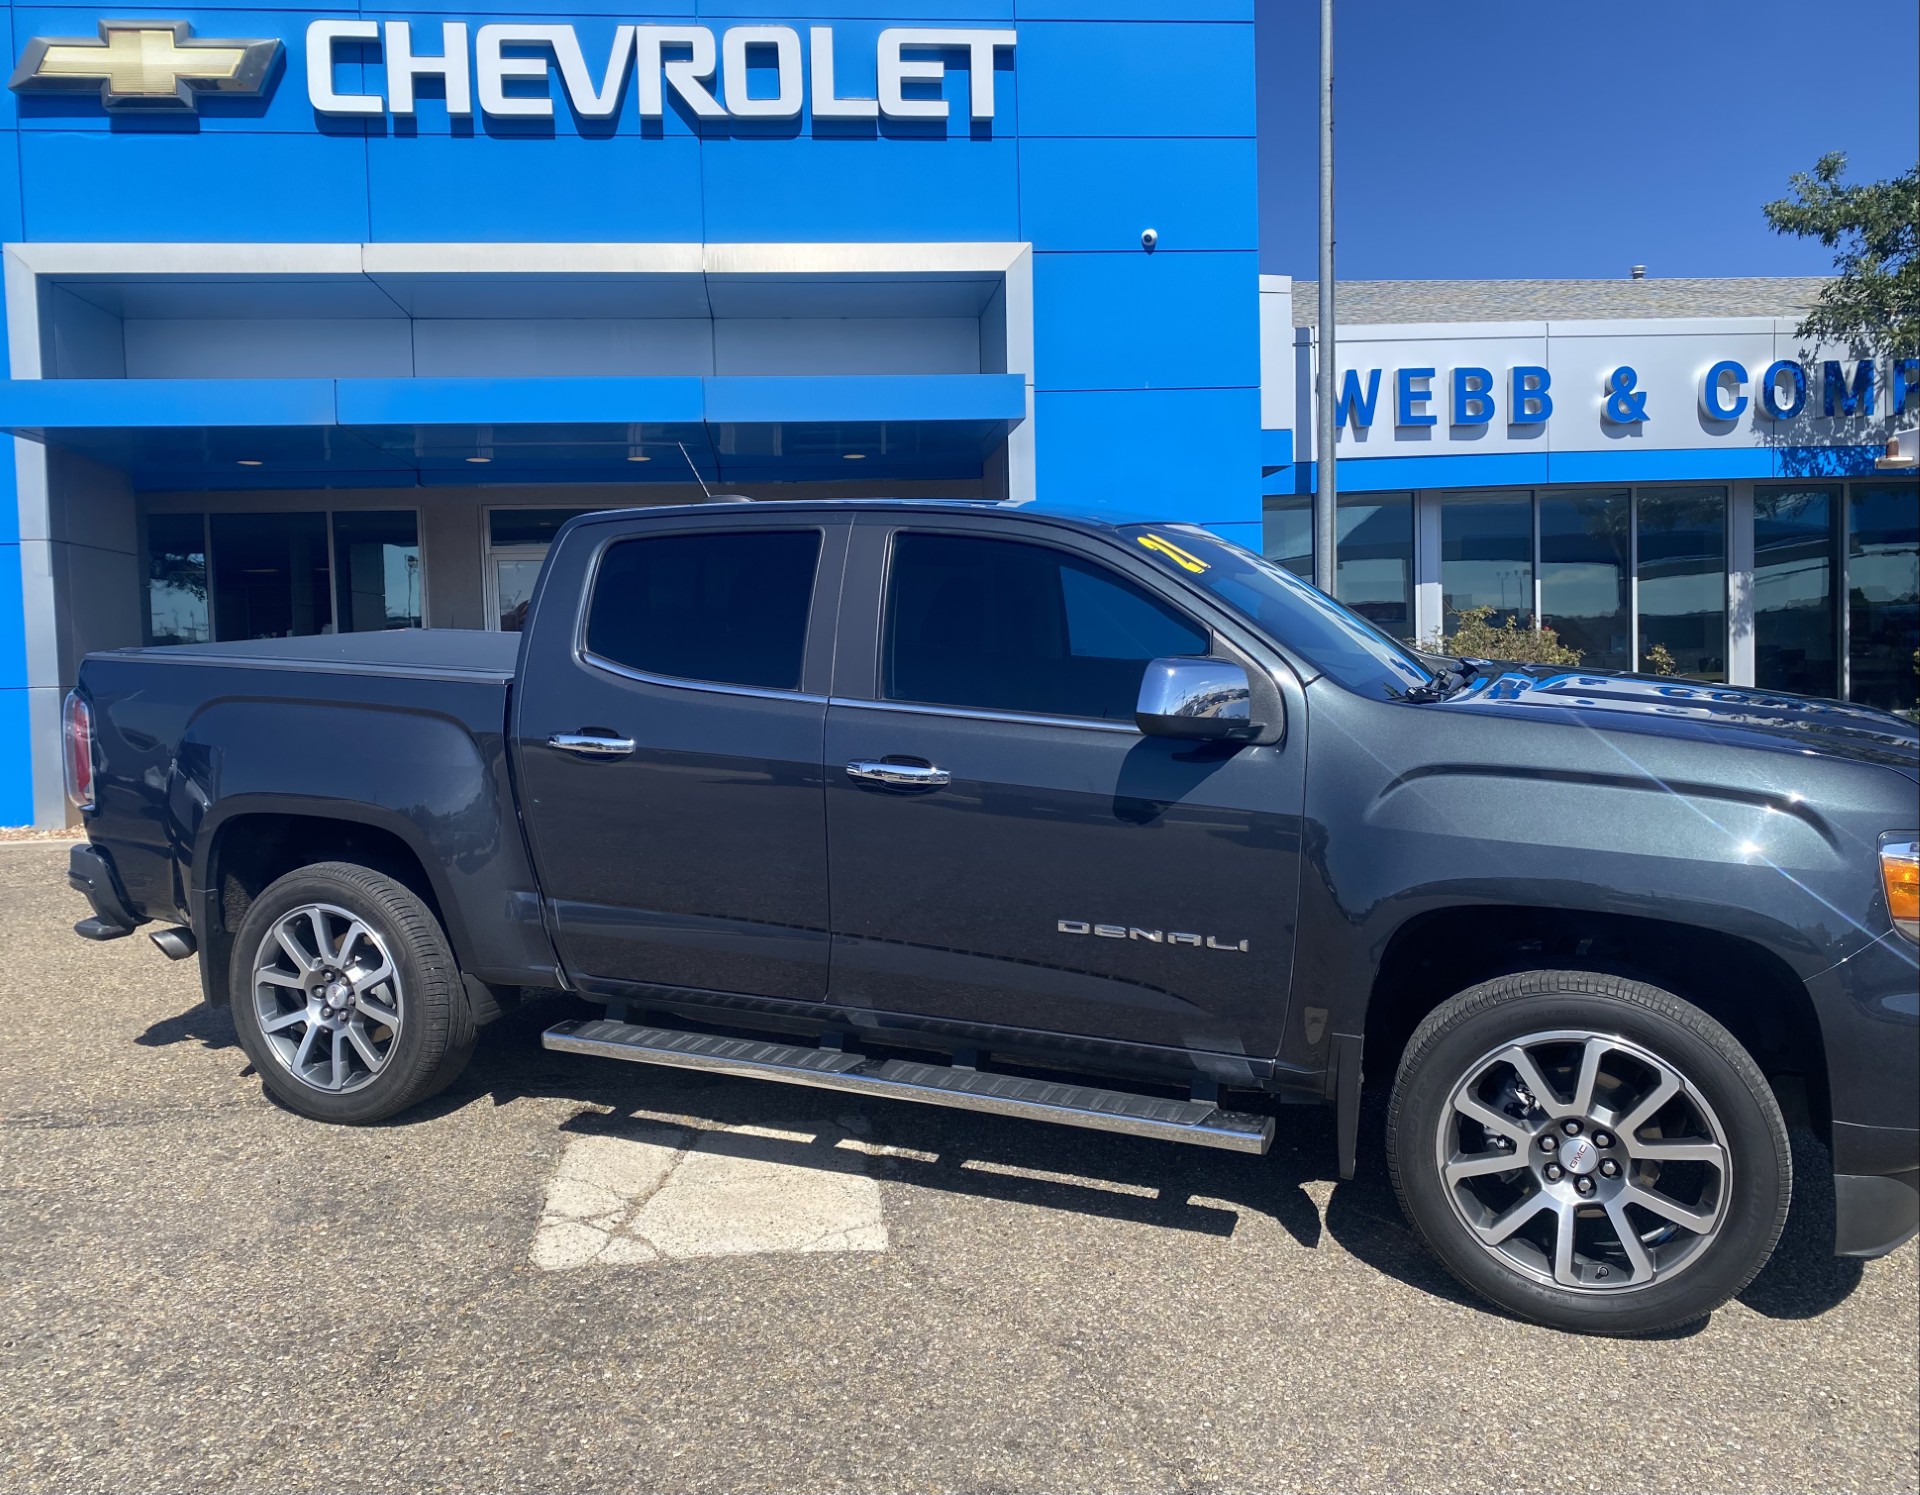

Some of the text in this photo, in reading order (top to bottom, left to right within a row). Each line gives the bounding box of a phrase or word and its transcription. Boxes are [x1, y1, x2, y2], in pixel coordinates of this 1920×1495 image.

[306, 19, 1017, 118] CHEVROLET
[1336, 366, 1553, 427] WEBB
[1608, 365, 1648, 425] &
[1137, 533, 1211, 574] 21
[1058, 919, 1249, 952] DENALI
[1569, 1144, 1588, 1169] GMC
